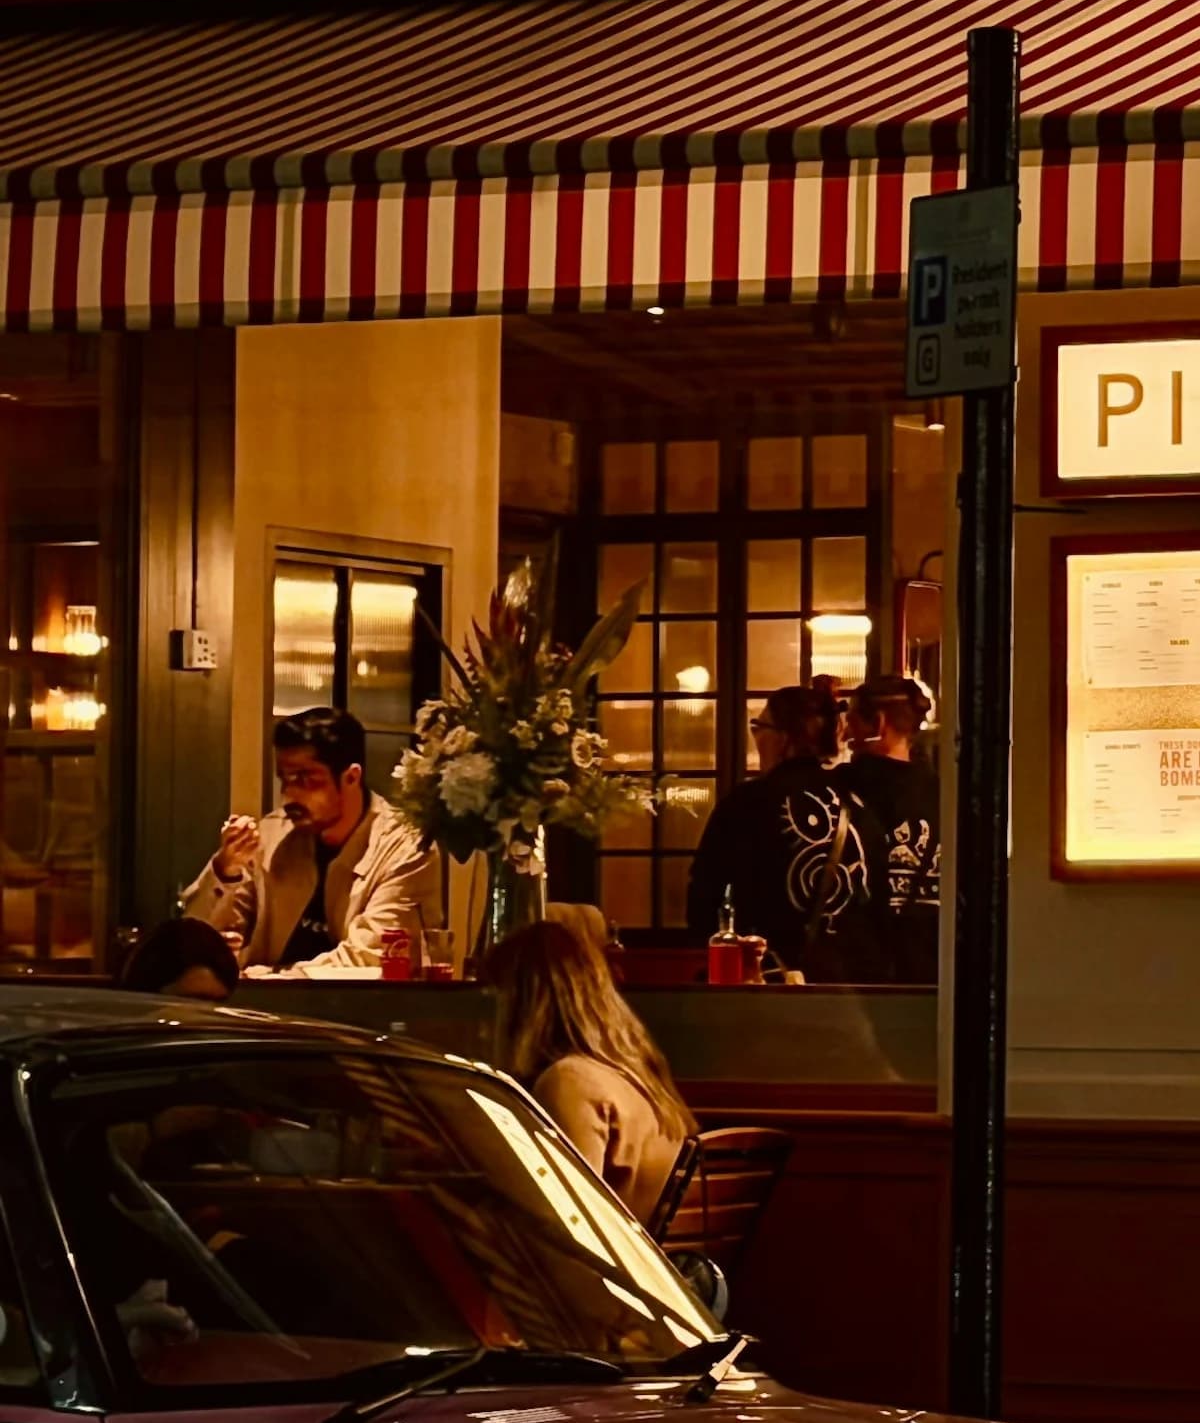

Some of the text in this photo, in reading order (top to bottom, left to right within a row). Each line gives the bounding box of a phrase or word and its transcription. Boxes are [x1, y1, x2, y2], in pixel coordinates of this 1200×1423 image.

[920, 264, 943, 320] P
[1159, 740, 1184, 750] THESE
[1160, 751, 1192, 768] ARE
